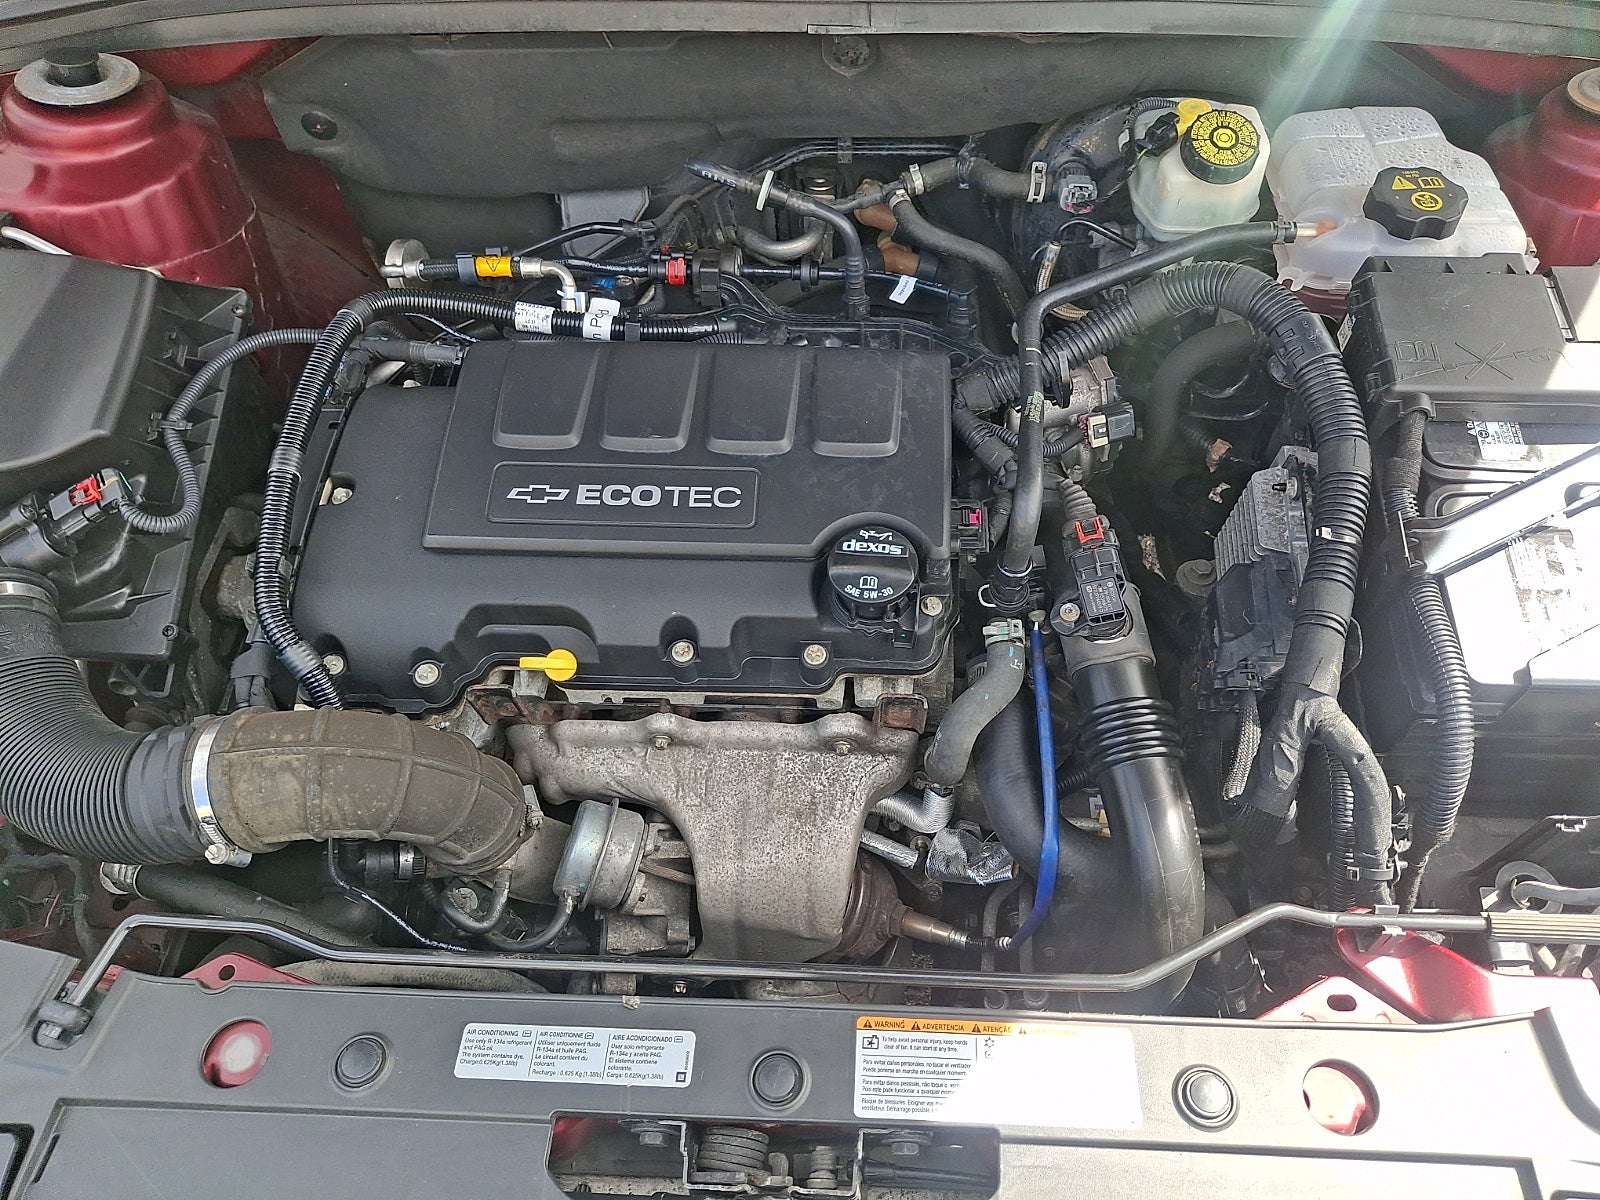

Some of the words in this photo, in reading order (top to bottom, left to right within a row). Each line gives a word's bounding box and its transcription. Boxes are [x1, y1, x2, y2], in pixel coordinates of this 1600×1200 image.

[576, 484, 742, 508] ECOTEC
[842, 539, 904, 554] dexos
[844, 584, 861, 598] SAE
[863, 586, 894, 599] 5W-30
[874, 1020, 905, 1028] WARNING
